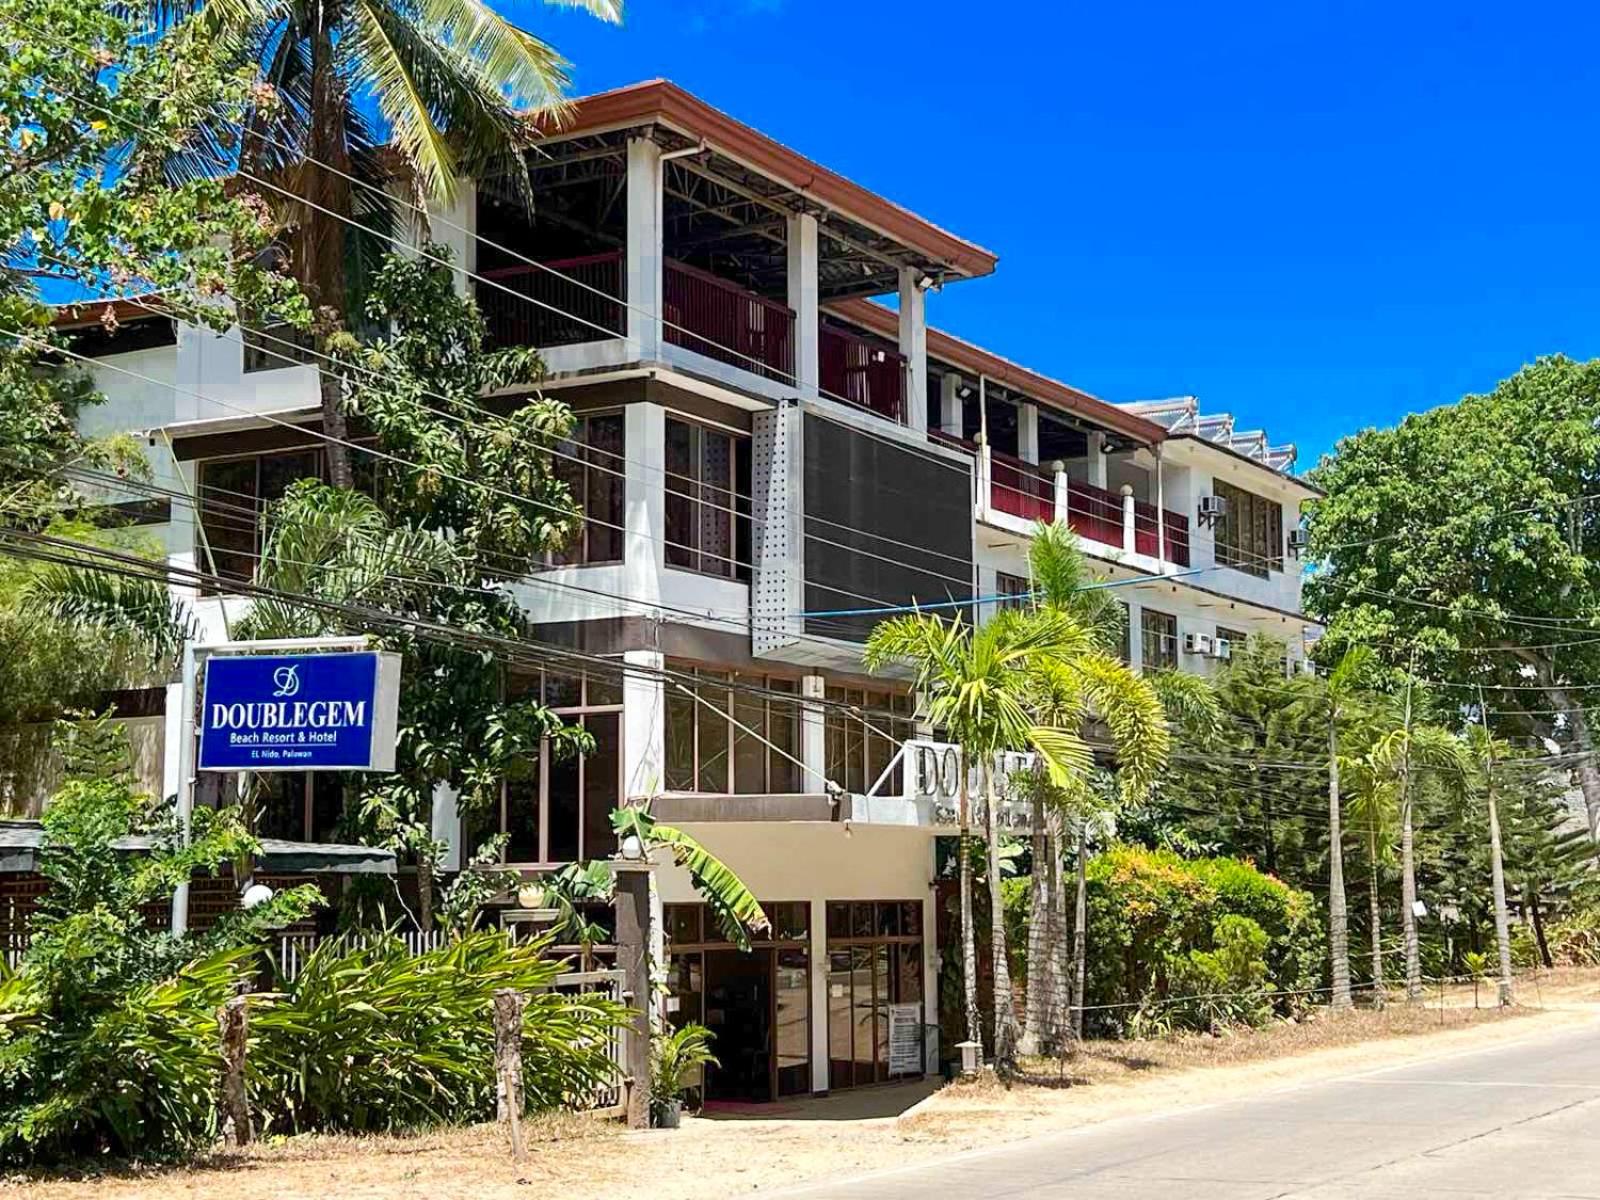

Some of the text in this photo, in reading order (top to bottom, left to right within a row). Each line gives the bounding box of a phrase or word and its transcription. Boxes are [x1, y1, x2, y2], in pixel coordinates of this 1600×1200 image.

[211, 701, 366, 729] DOUBLEGEM
[230, 730, 337, 744] Beach Resort & Hotel
